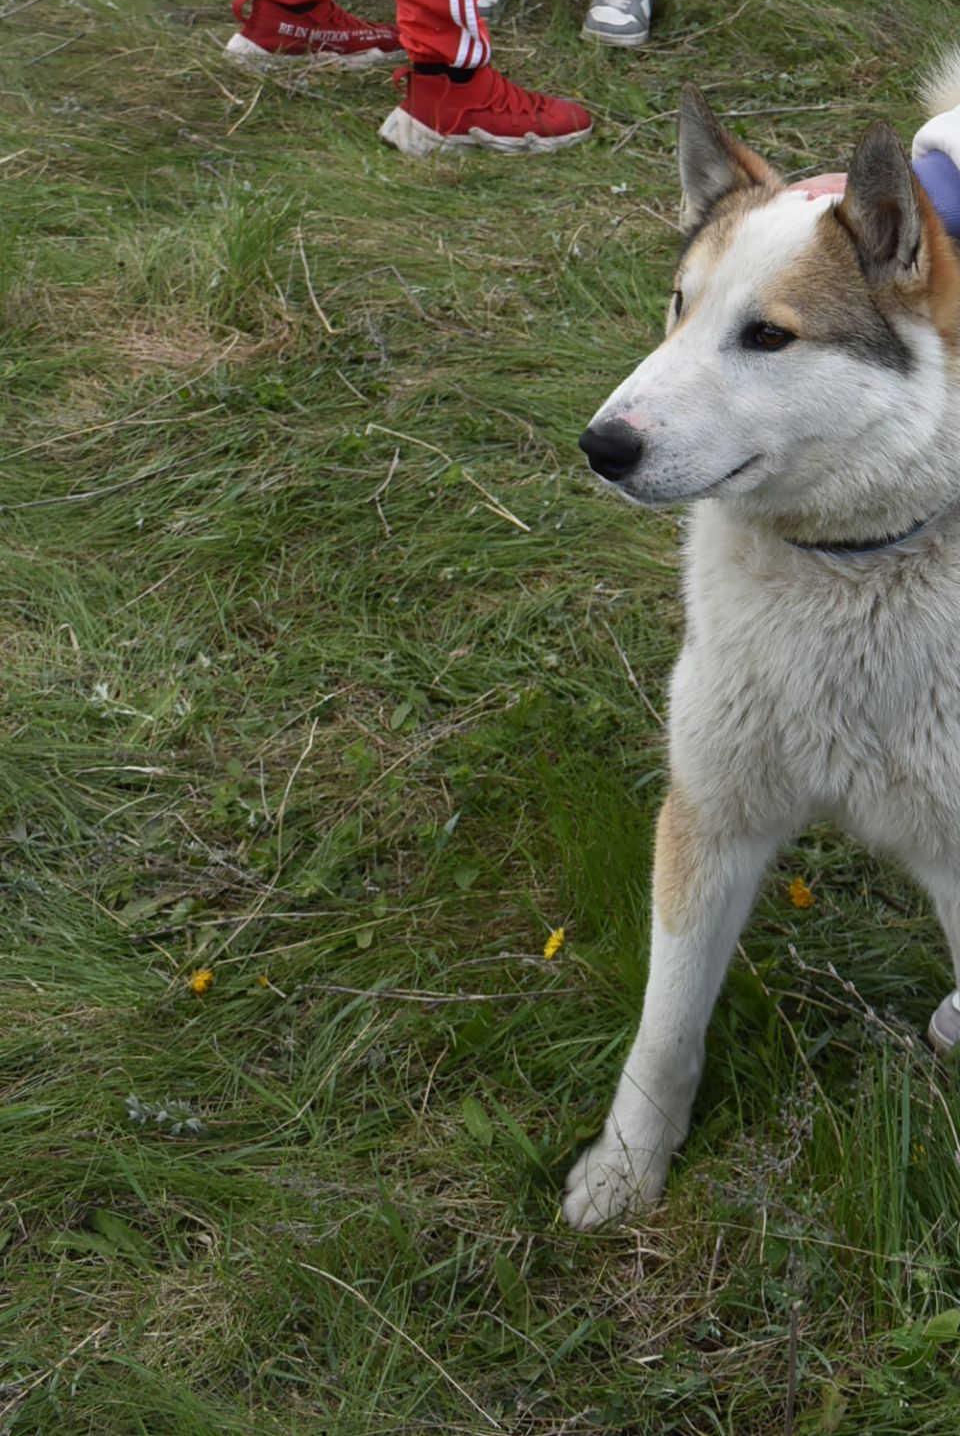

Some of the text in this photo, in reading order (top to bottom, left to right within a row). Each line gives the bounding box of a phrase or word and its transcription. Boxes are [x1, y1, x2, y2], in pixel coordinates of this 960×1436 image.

[278, 22, 293, 37] BE
[294, 26, 309, 38] IN
[310, 29, 350, 42] MOTION
